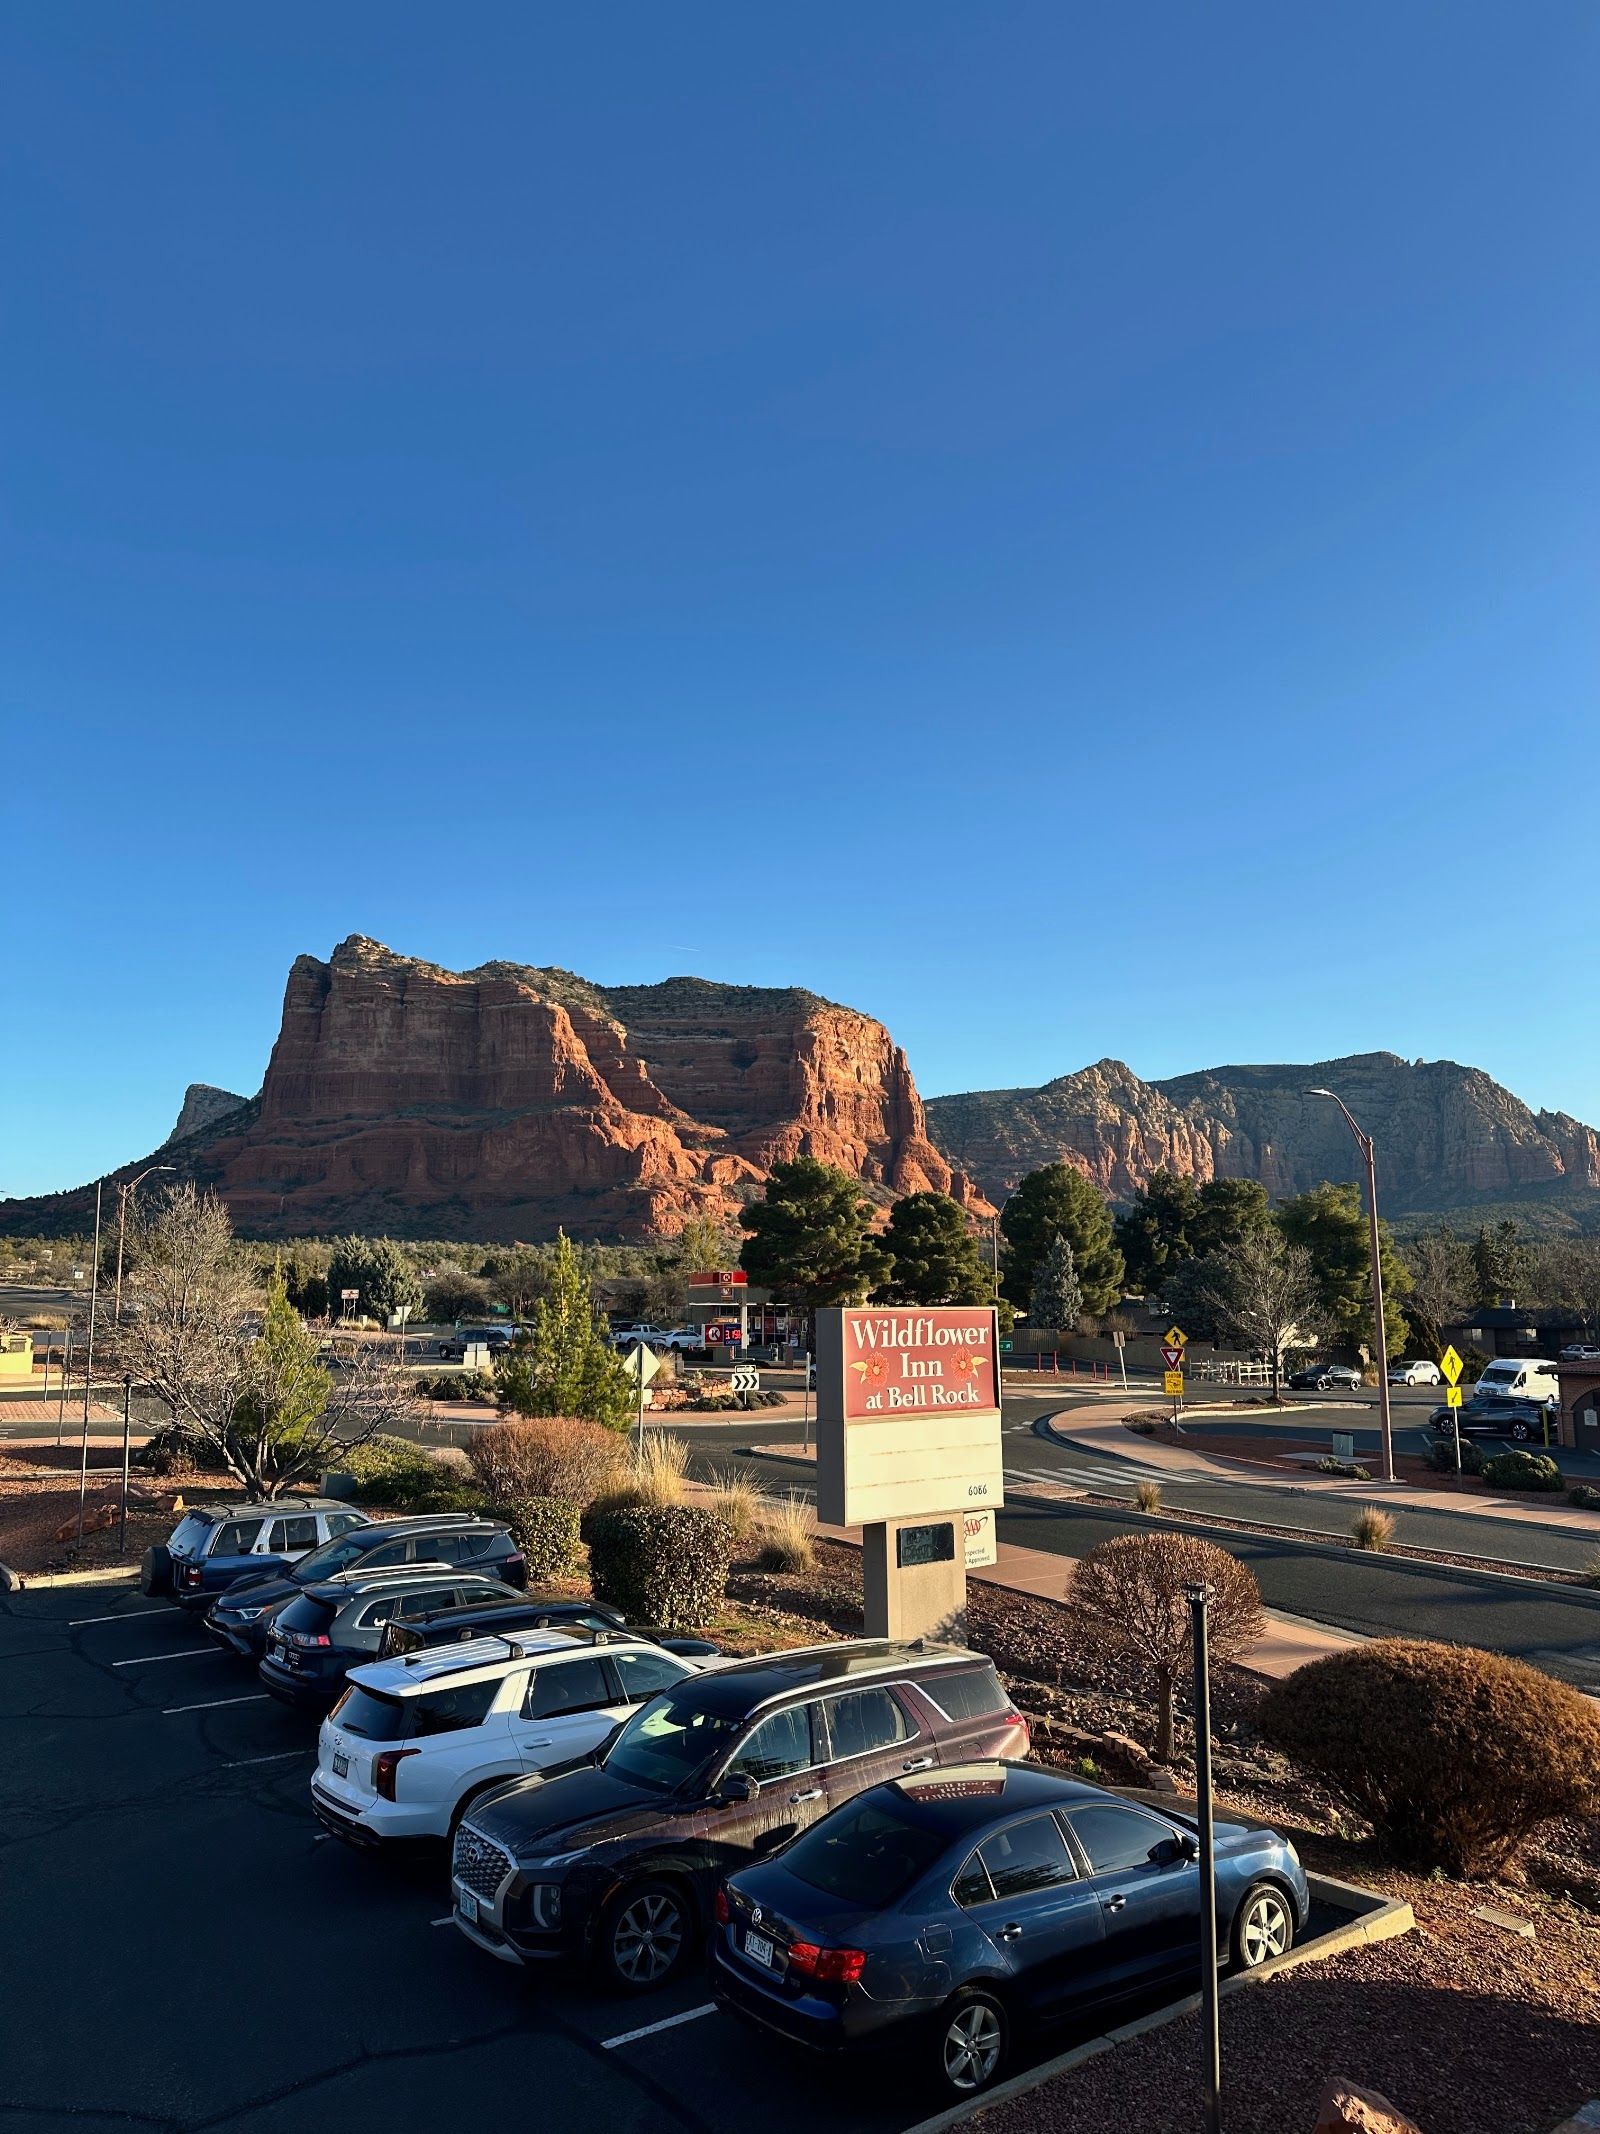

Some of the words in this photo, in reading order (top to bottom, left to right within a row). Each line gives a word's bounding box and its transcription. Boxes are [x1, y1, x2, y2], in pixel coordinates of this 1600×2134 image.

[851, 1318, 988, 1349] Wildflower
[900, 1352, 944, 1378] Inn
[865, 1391, 883, 1410] at
[887, 1384, 927, 1408] Bell
[931, 1382, 980, 1405] Rock
[968, 1484, 987, 1496] 6086
